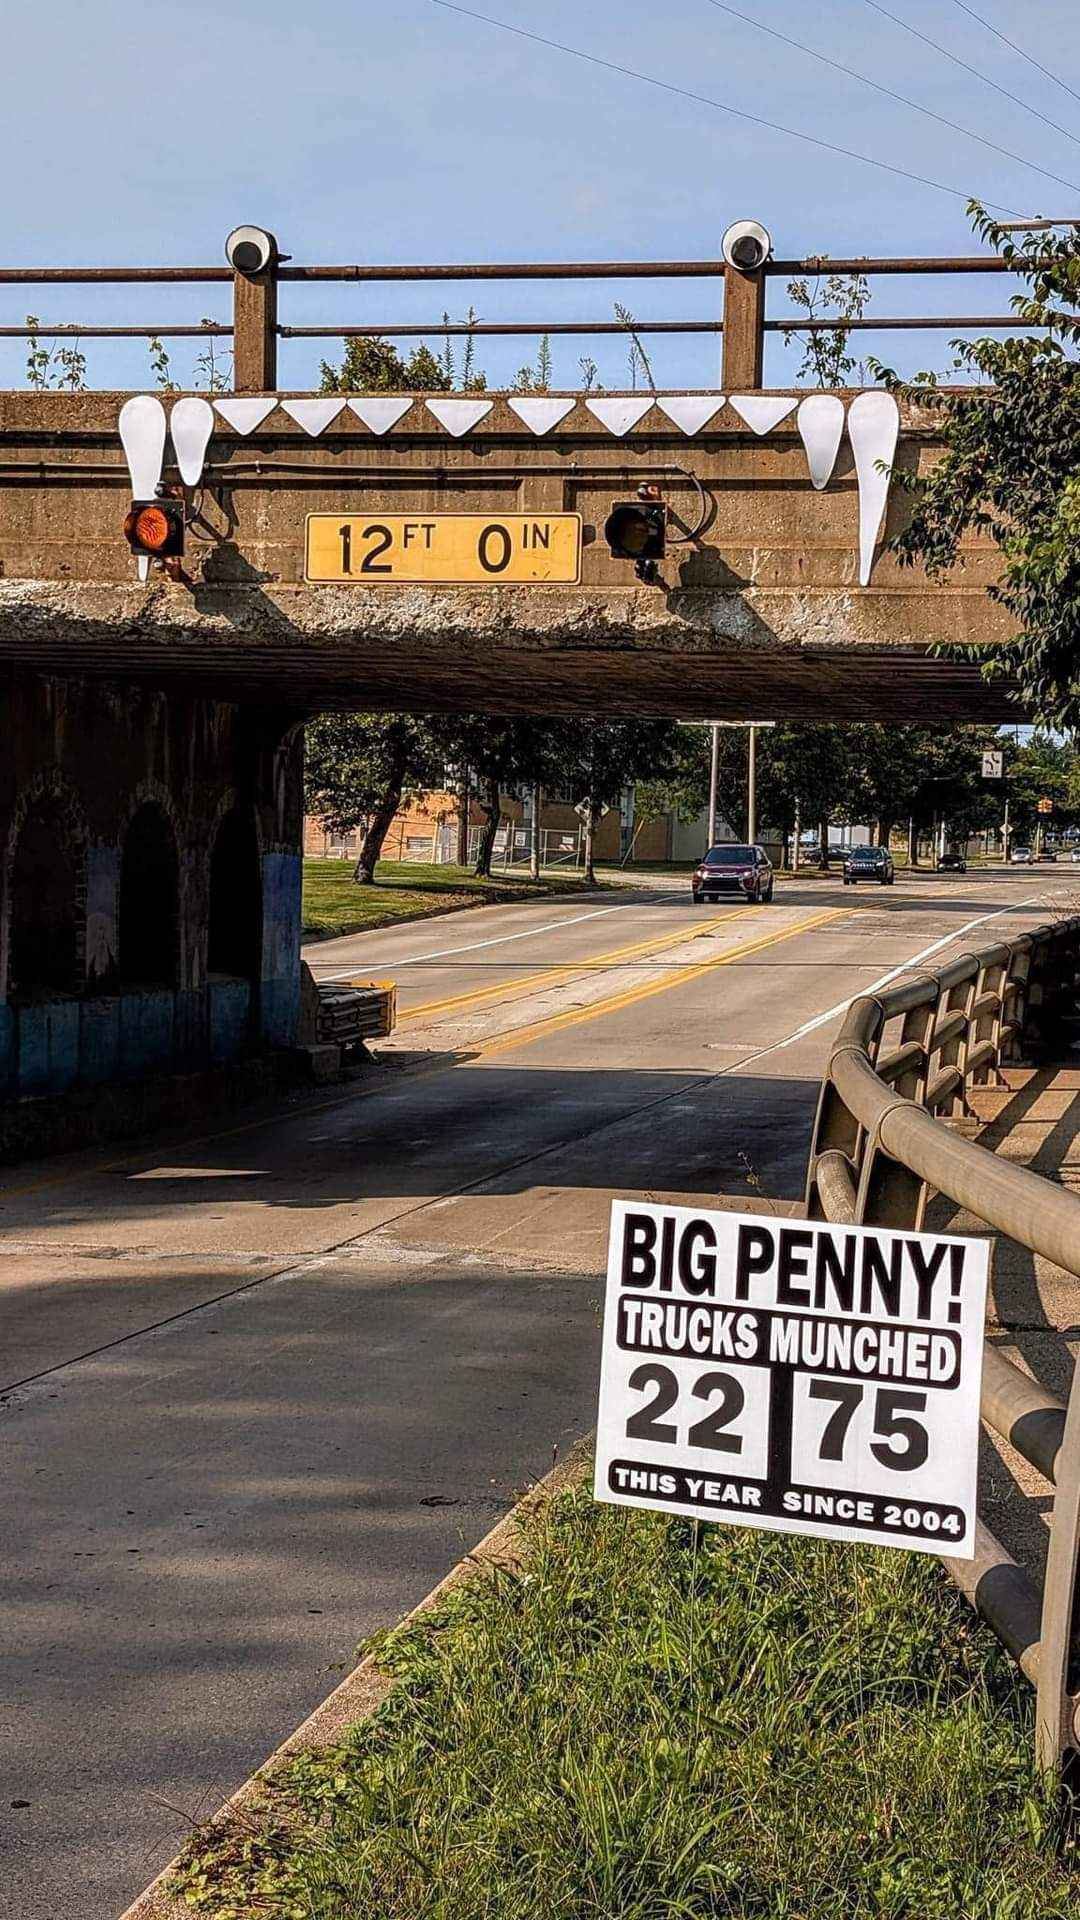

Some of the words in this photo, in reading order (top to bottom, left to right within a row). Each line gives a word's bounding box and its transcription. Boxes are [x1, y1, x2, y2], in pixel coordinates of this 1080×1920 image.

[339, 524, 393, 573] 12
[403, 524, 436, 548] FT
[478, 524, 512, 573] 0
[523, 524, 549, 549] IN
[621, 1213, 717, 1297] BIG
[735, 1224, 966, 1324] PENNY!
[623, 1300, 759, 1360] TRUCKS
[769, 1317, 957, 1383] MUNCHED
[625, 1363, 746, 1455] 22
[809, 1378, 929, 1472] 75
[615, 1467, 677, 1494] THIS
[685, 1478, 762, 1507] YEAR
[782, 1491, 875, 1522] SINCE
[882, 1505, 961, 1536] 2004
